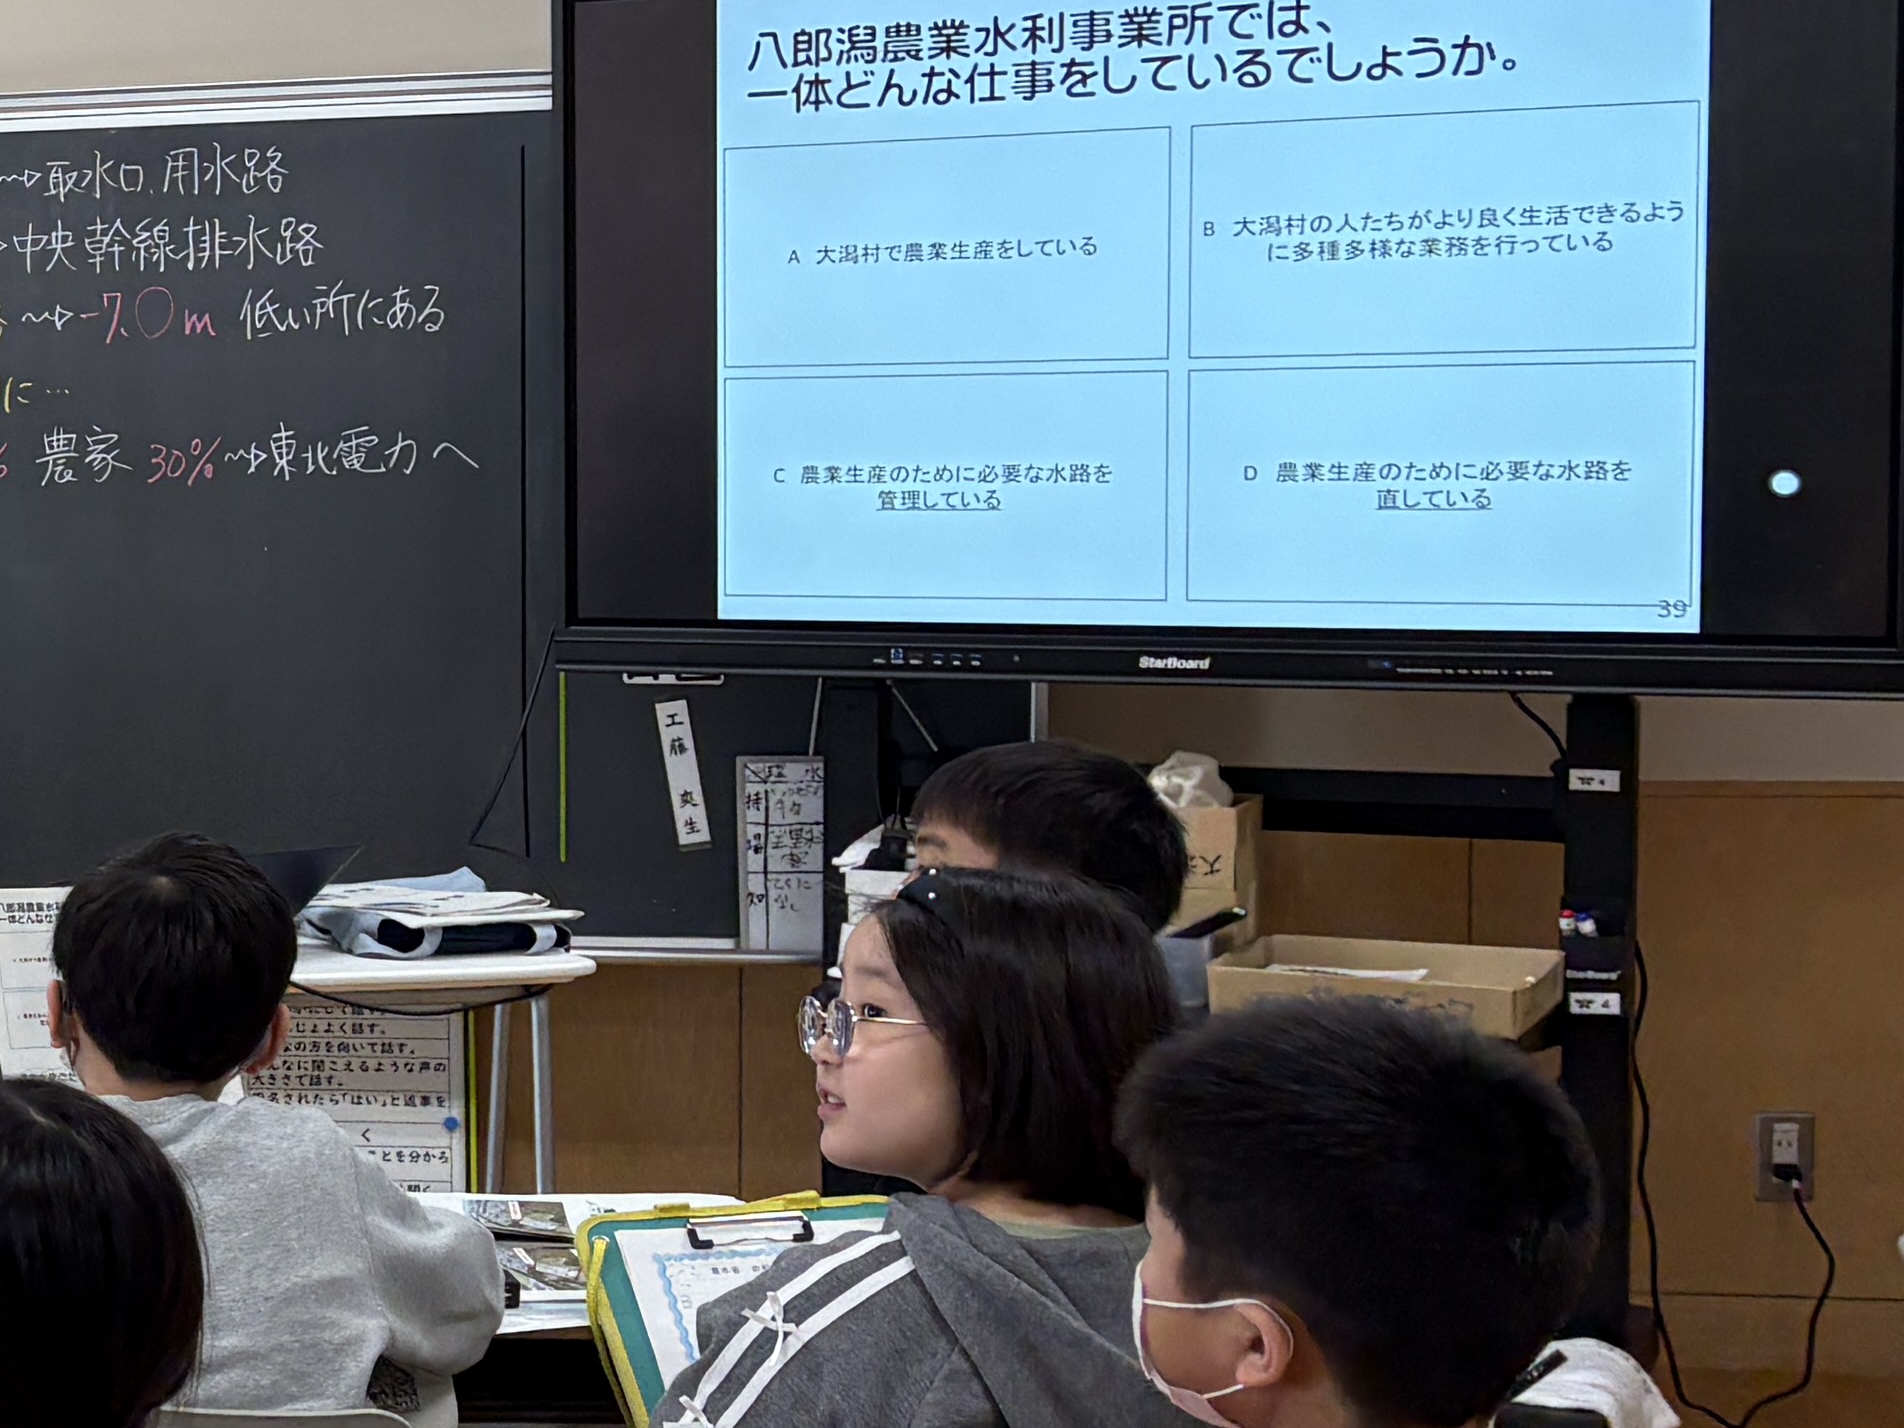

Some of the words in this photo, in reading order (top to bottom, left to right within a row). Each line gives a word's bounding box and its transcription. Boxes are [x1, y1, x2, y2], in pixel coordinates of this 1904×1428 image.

[746, 33, 1520, 114] 一体どんな仕事をしているでしょうか。
[1203, 221, 1215, 237] B
[1232, 199, 1685, 239] 大潟村の人たちがより良く生活できるよう
[13, 215, 325, 274] 中央幹線排水路
[787, 249, 801, 265] A
[815, 236, 1098, 265] 大潟村で農業生産をしている
[1267, 231, 1614, 263] に多種多様な業務を行っている
[239, 278, 446, 340] 低い所にある
[35, 425, 134, 486] 農家
[146, 436, 223, 486] 30%
[269, 421, 481, 483] 東北電力へ
[773, 468, 786, 484] C
[800, 463, 1113, 485] 農業生産のために必要な水路を
[1244, 465, 1258, 482] D
[1276, 459, 1632, 483] 農業生産のために必要な水路を
[877, 489, 1002, 510] 管理している
[1376, 487, 1492, 510] 直している
[1657, 599, 1688, 618] 39
[1138, 655, 1211, 670] StarBoard
[251, 1073, 344, 1087] 大きさで話す。
